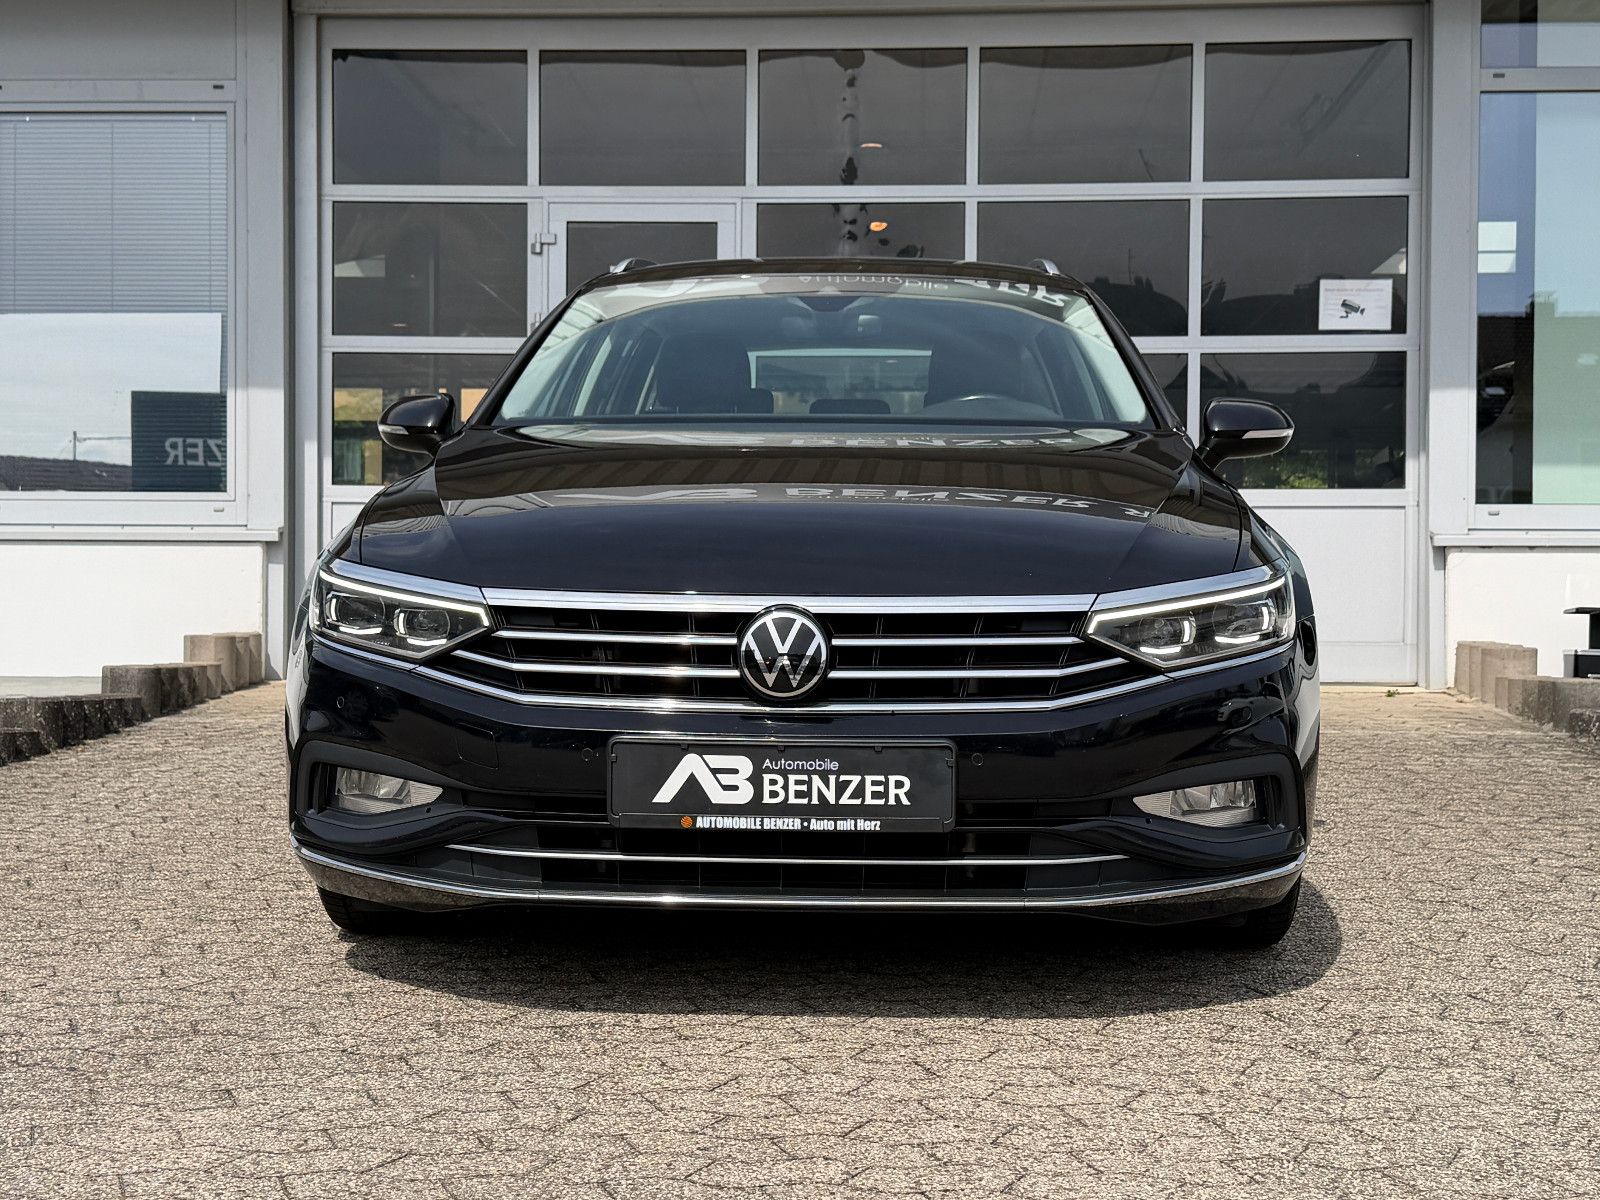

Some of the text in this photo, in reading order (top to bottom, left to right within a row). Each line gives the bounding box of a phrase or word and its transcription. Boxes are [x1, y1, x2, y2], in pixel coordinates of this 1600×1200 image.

[762, 758, 839, 770] Automobile
[761, 773, 911, 806] BENZER
[695, 816, 881, 831] AUTOMOBILE BENZER Auto mit Herz
